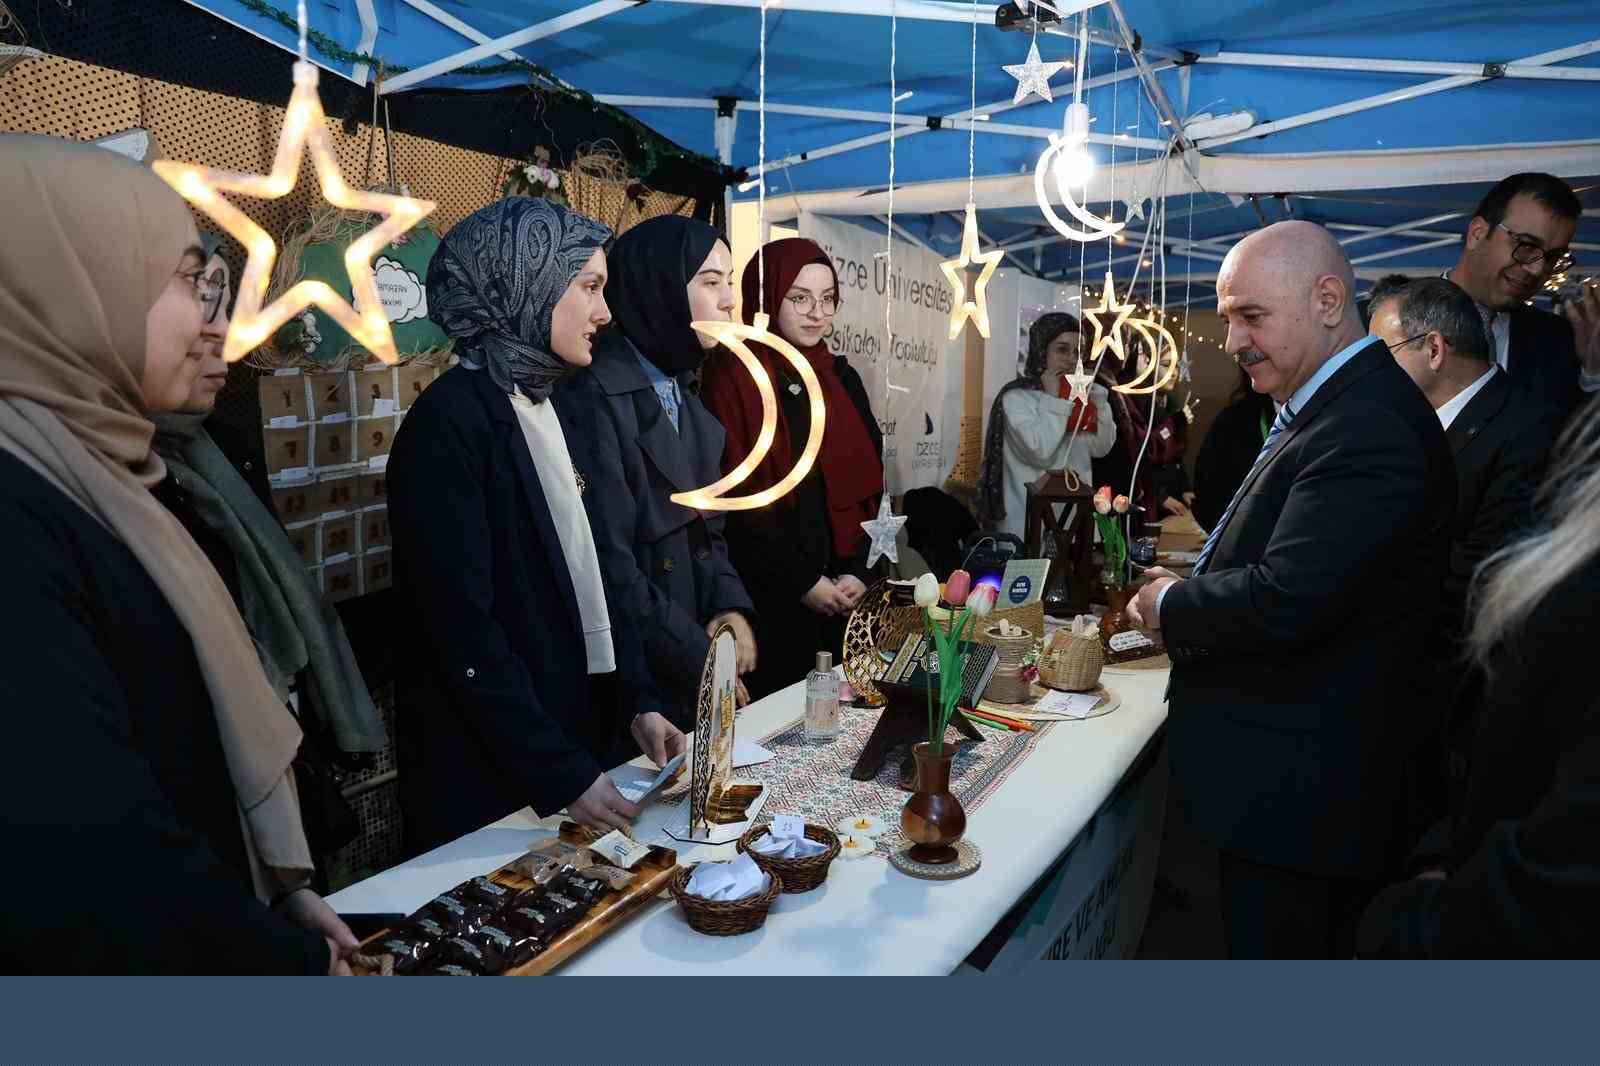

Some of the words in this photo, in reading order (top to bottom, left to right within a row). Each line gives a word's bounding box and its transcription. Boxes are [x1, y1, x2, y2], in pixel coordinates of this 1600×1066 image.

[326, 385, 339, 401] 2
[285, 441, 297, 459] 7
[372, 430, 384, 447] 9
